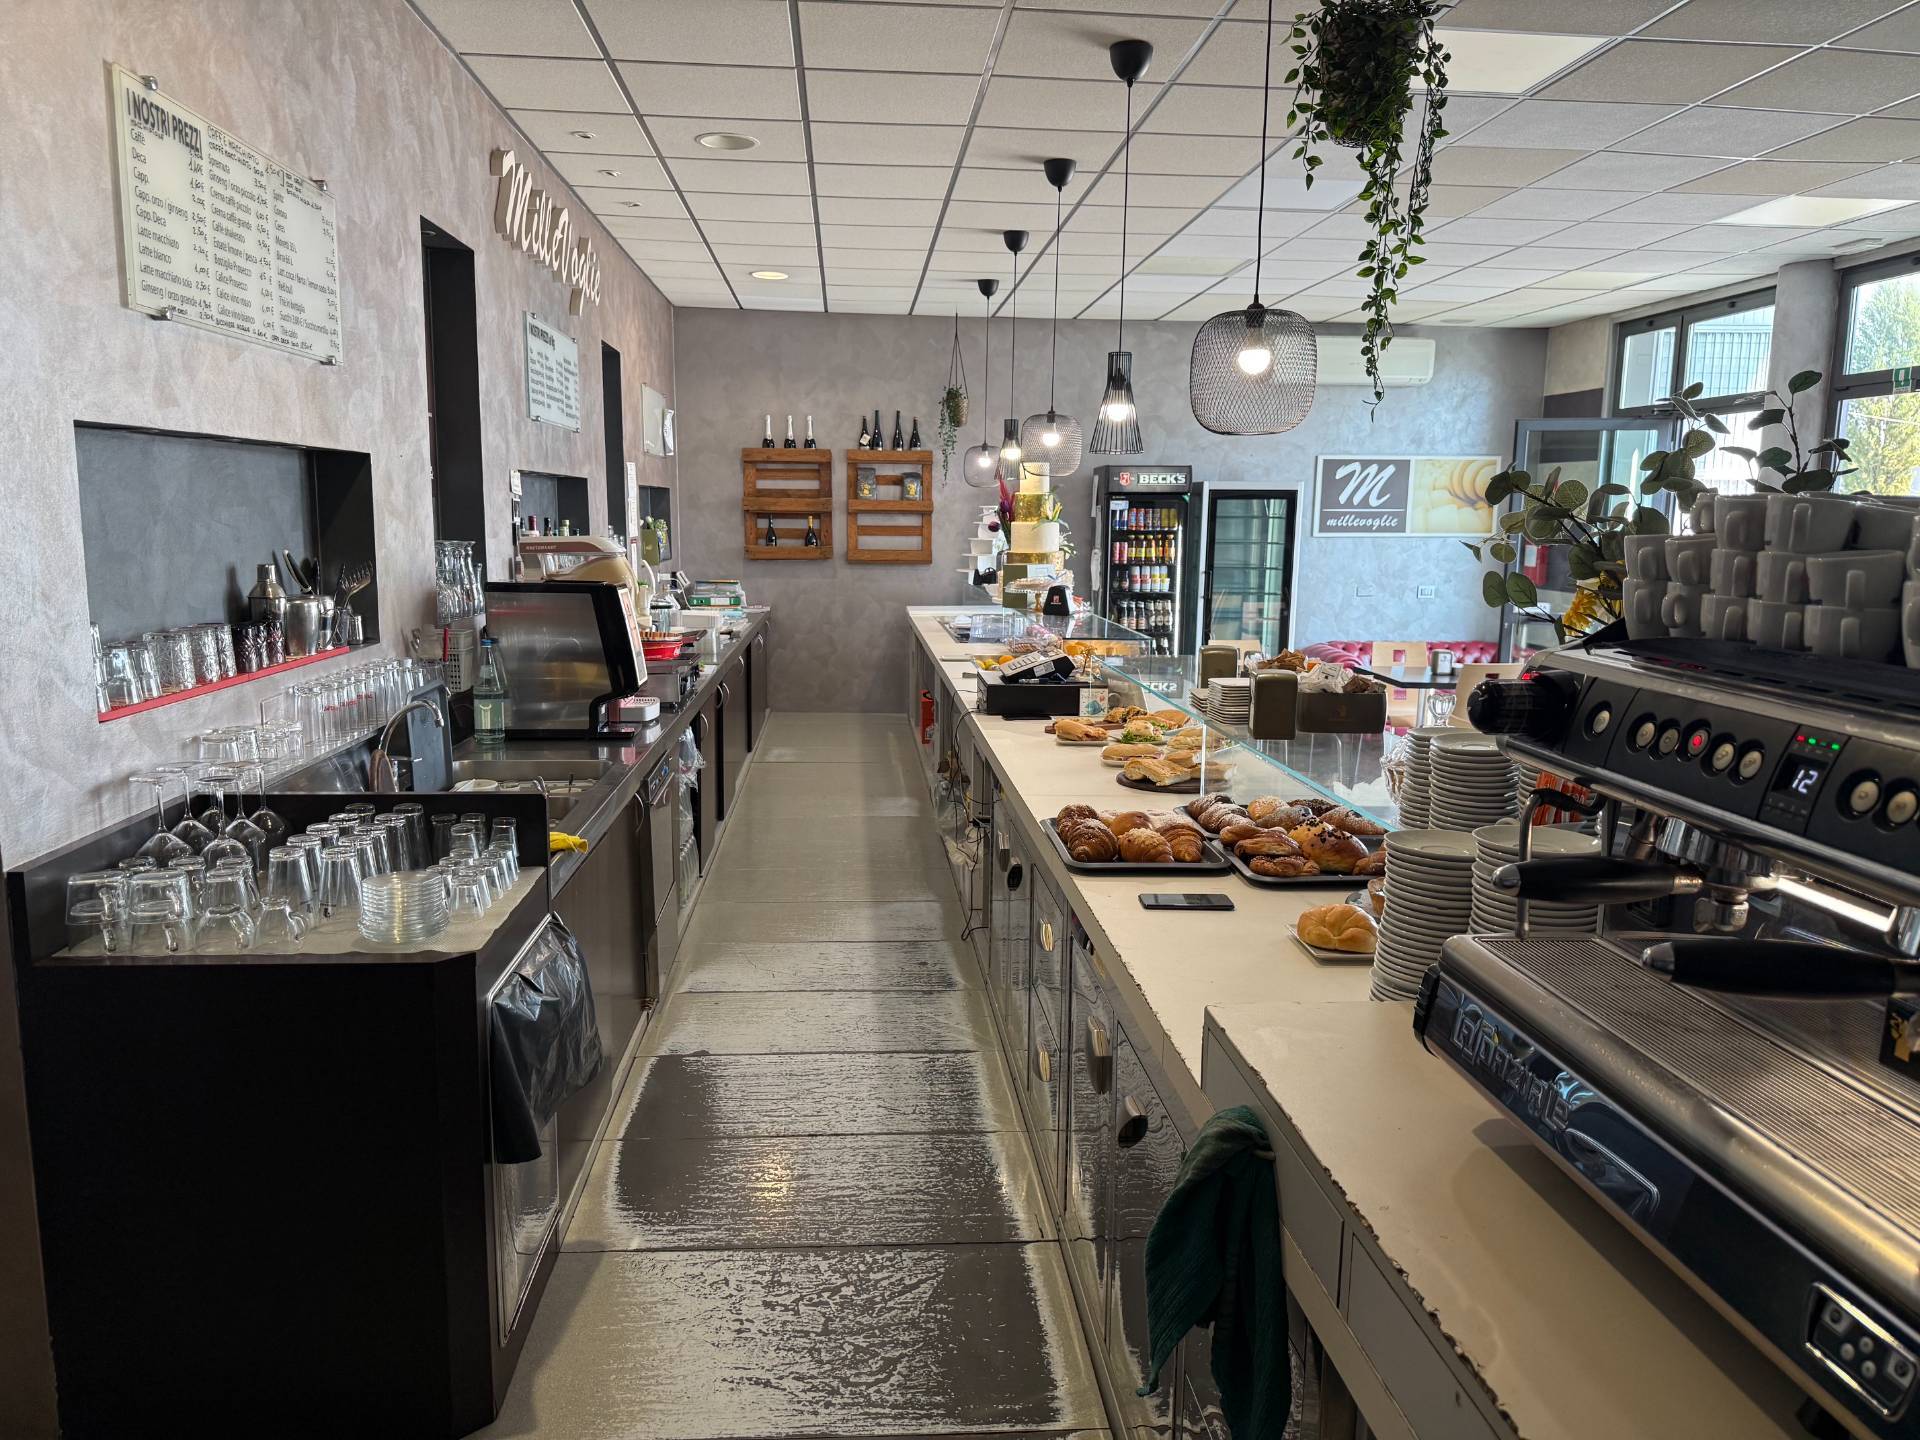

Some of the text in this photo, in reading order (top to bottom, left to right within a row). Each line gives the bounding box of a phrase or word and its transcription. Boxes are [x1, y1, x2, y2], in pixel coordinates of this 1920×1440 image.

[133, 92, 170, 137] NOSTRI
[172, 114, 202, 153] PREZZI
[1140, 473, 1186, 485] BECK'S
[1326, 513, 1399, 531] millevoglie
[1792, 768, 1819, 794] 12
